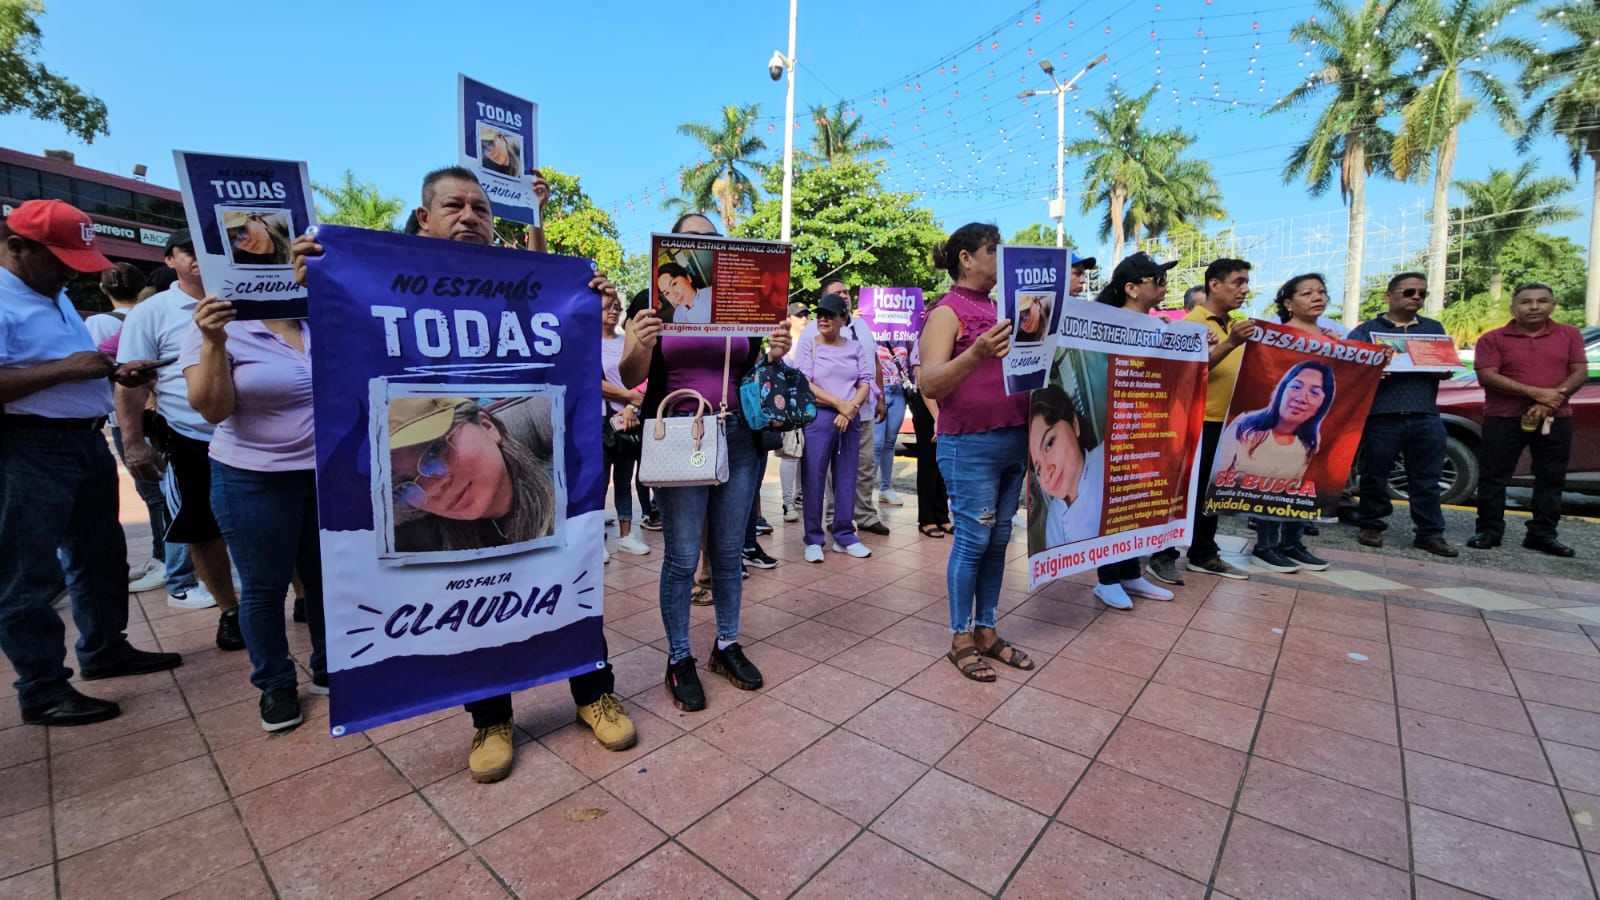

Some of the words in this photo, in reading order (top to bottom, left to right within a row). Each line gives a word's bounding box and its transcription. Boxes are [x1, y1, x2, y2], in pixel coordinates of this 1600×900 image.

[476, 101, 522, 127] TODAS
[210, 180, 286, 199] TODAS
[661, 239, 695, 249] CLAUDIA
[697, 241, 727, 250] ESTHER
[391, 273, 428, 296] NO
[1015, 268, 1057, 285] TODAS
[235, 281, 300, 294] CLAUDIA
[873, 288, 915, 309] Hasta
[371, 305, 562, 358] TODAS
[704, 325, 719, 333] que
[1090, 321, 1128, 344] ESTHER
[1215, 470, 1238, 487] SE
[1240, 473, 1317, 498] BUSCA
[1237, 490, 1261, 500] Esther
[1253, 505, 1264, 513] a
[1267, 504, 1322, 520] volver!
[1033, 553, 1086, 584] ¡Exigimos
[1089, 546, 1109, 564] que
[1112, 541, 1131, 554] nos
[1134, 536, 1143, 549] la
[446, 578, 473, 590] NOS
[474, 572, 512, 588] FALTA
[384, 584, 562, 639] CLAUDIA
